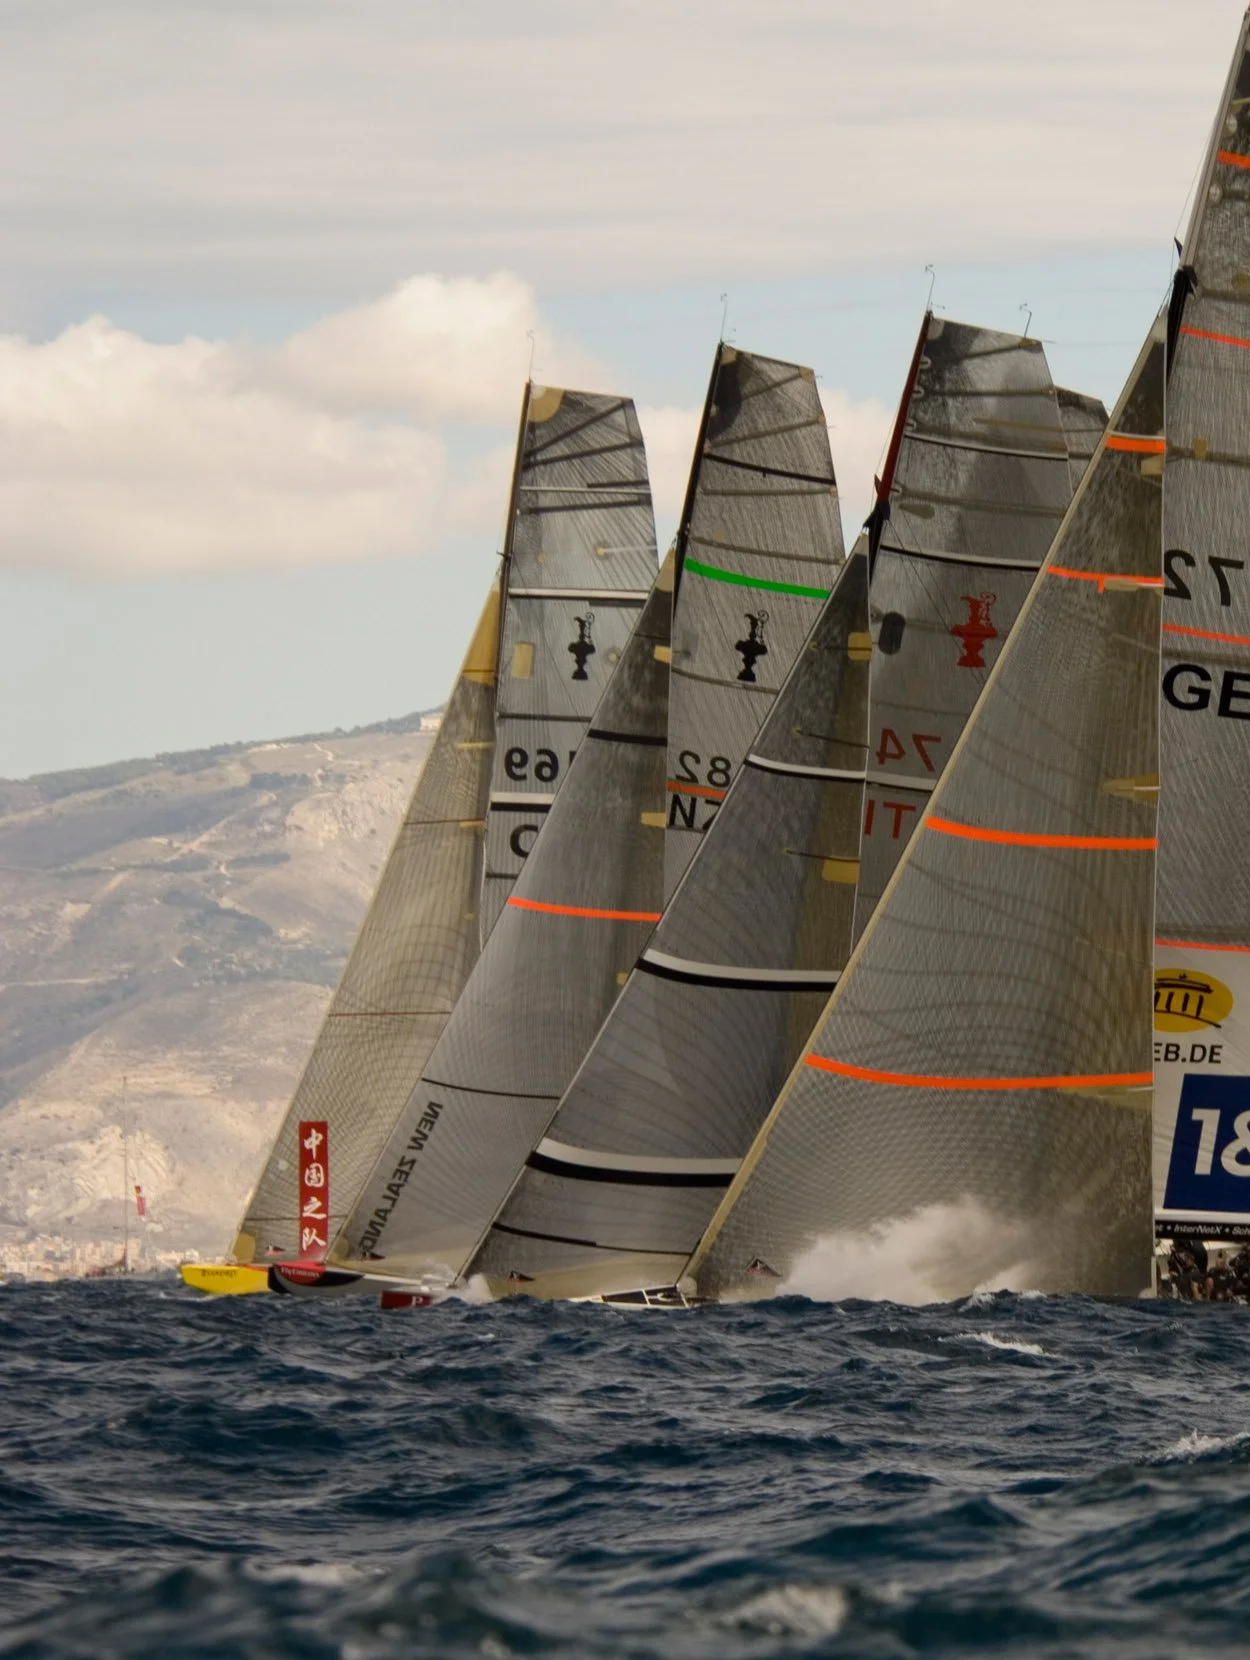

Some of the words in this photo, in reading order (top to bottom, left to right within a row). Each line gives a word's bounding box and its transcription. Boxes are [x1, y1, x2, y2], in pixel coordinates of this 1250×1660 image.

[864, 799, 916, 839] IT
[302, 1128, 326, 1251] 中国之队
